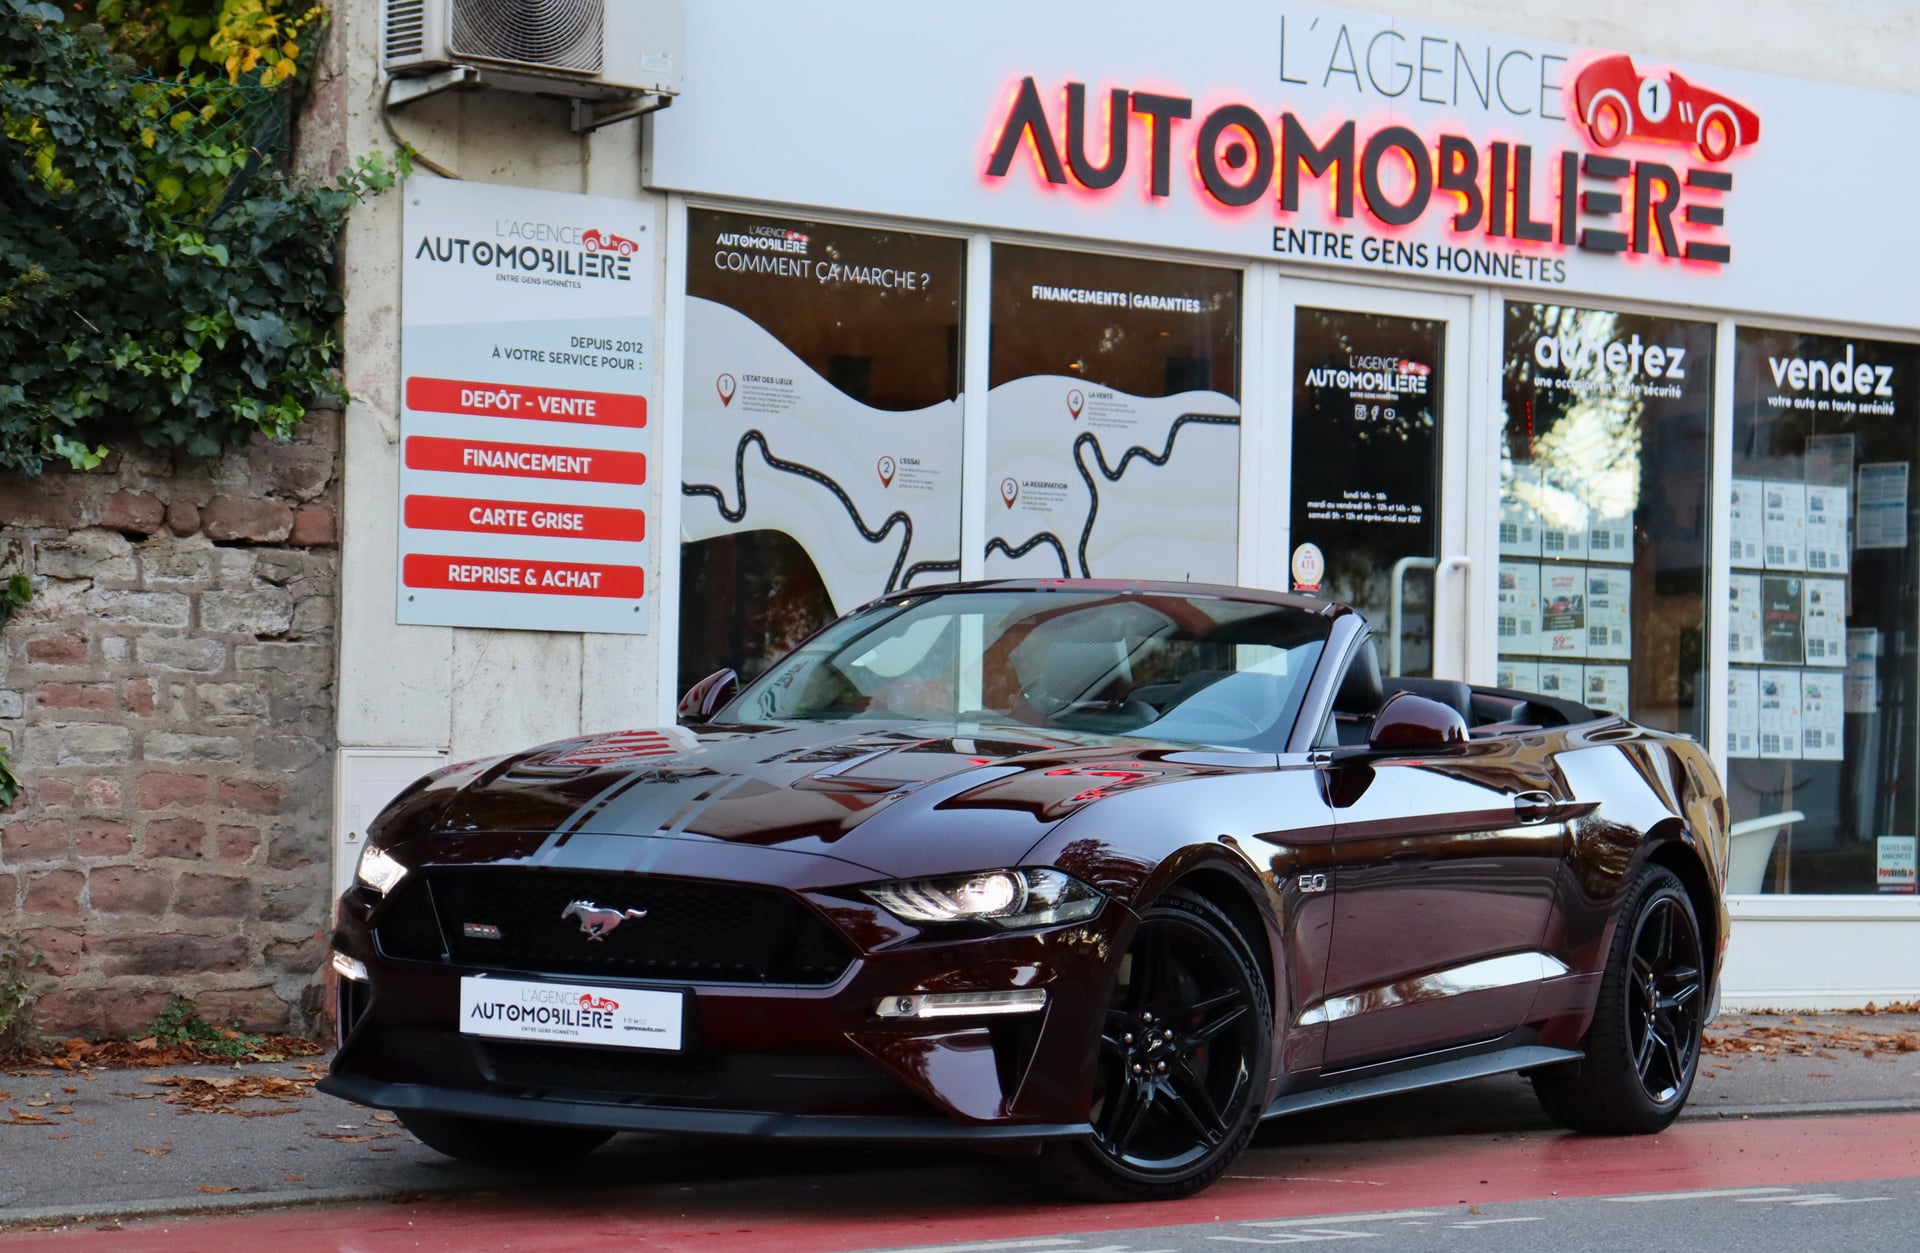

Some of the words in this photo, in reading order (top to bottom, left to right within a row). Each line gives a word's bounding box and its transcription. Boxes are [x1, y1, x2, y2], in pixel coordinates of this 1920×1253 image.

[1280, 14, 1567, 121] L'AGENCE
[986, 75, 1733, 265] AUTOMOBILIERE
[496, 219, 582, 245] L'AGENCE
[716, 233, 808, 254] AUTOMOBILIERE
[749, 225, 787, 238] L'AGENCE
[415, 235, 631, 281] AUTOMOBILIERE
[1273, 226, 1354, 259] ENTRE
[1361, 236, 1428, 268] GENS
[1437, 249, 1566, 283] HONNÊTES
[496, 273, 519, 283] ENTRE
[521, 276, 541, 285] GENS
[542, 278, 581, 289] HONNÊTES
[714, 250, 811, 278] COMMENT
[816, 261, 840, 284] ÇA
[843, 265, 917, 290] MARCHE
[1032, 284, 1127, 306] FINANCEMENTS
[1133, 296, 1200, 313] GARANTIES
[492, 344, 501, 359] À
[504, 347, 545, 363] VOTRE
[548, 352, 598, 367] SERVICE
[601, 356, 634, 370] POUR
[570, 336, 613, 351] DEPUIS
[616, 340, 643, 354] 2012
[1534, 333, 1686, 379] achetez
[1349, 354, 1399, 371] L'AGENCE
[1769, 343, 1894, 397] vendez
[1305, 368, 1427, 394] AUTOMOBILIERE
[1534, 376, 1553, 388] une
[1555, 378, 1597, 391] occasion
[1599, 382, 1612, 393] en
[1614, 382, 1641, 395] toute
[1643, 382, 1682, 399] sécurité
[461, 389, 521, 411] DEPÔT
[537, 395, 596, 417] VENTE
[1767, 395, 1792, 408] votre
[1794, 397, 1816, 410] auto
[1818, 400, 1830, 411] en
[1832, 399, 1857, 413] toute
[463, 448, 592, 474] FINANCEMENT
[1307, 500, 1326, 508] mardi
[1336, 501, 1363, 510] vendredi
[1343, 490, 1359, 499] lundi
[469, 507, 528, 528] CARTE
[531, 511, 583, 531] GRISE
[1308, 511, 1331, 519] samedi
[448, 564, 520, 585] REPRISE
[524, 568, 536, 585] &
[541, 569, 601, 589] ACHAT
[521, 987, 580, 1008] L'AGENCE
[471, 1002, 613, 1030] AUTOMOBILIERE
